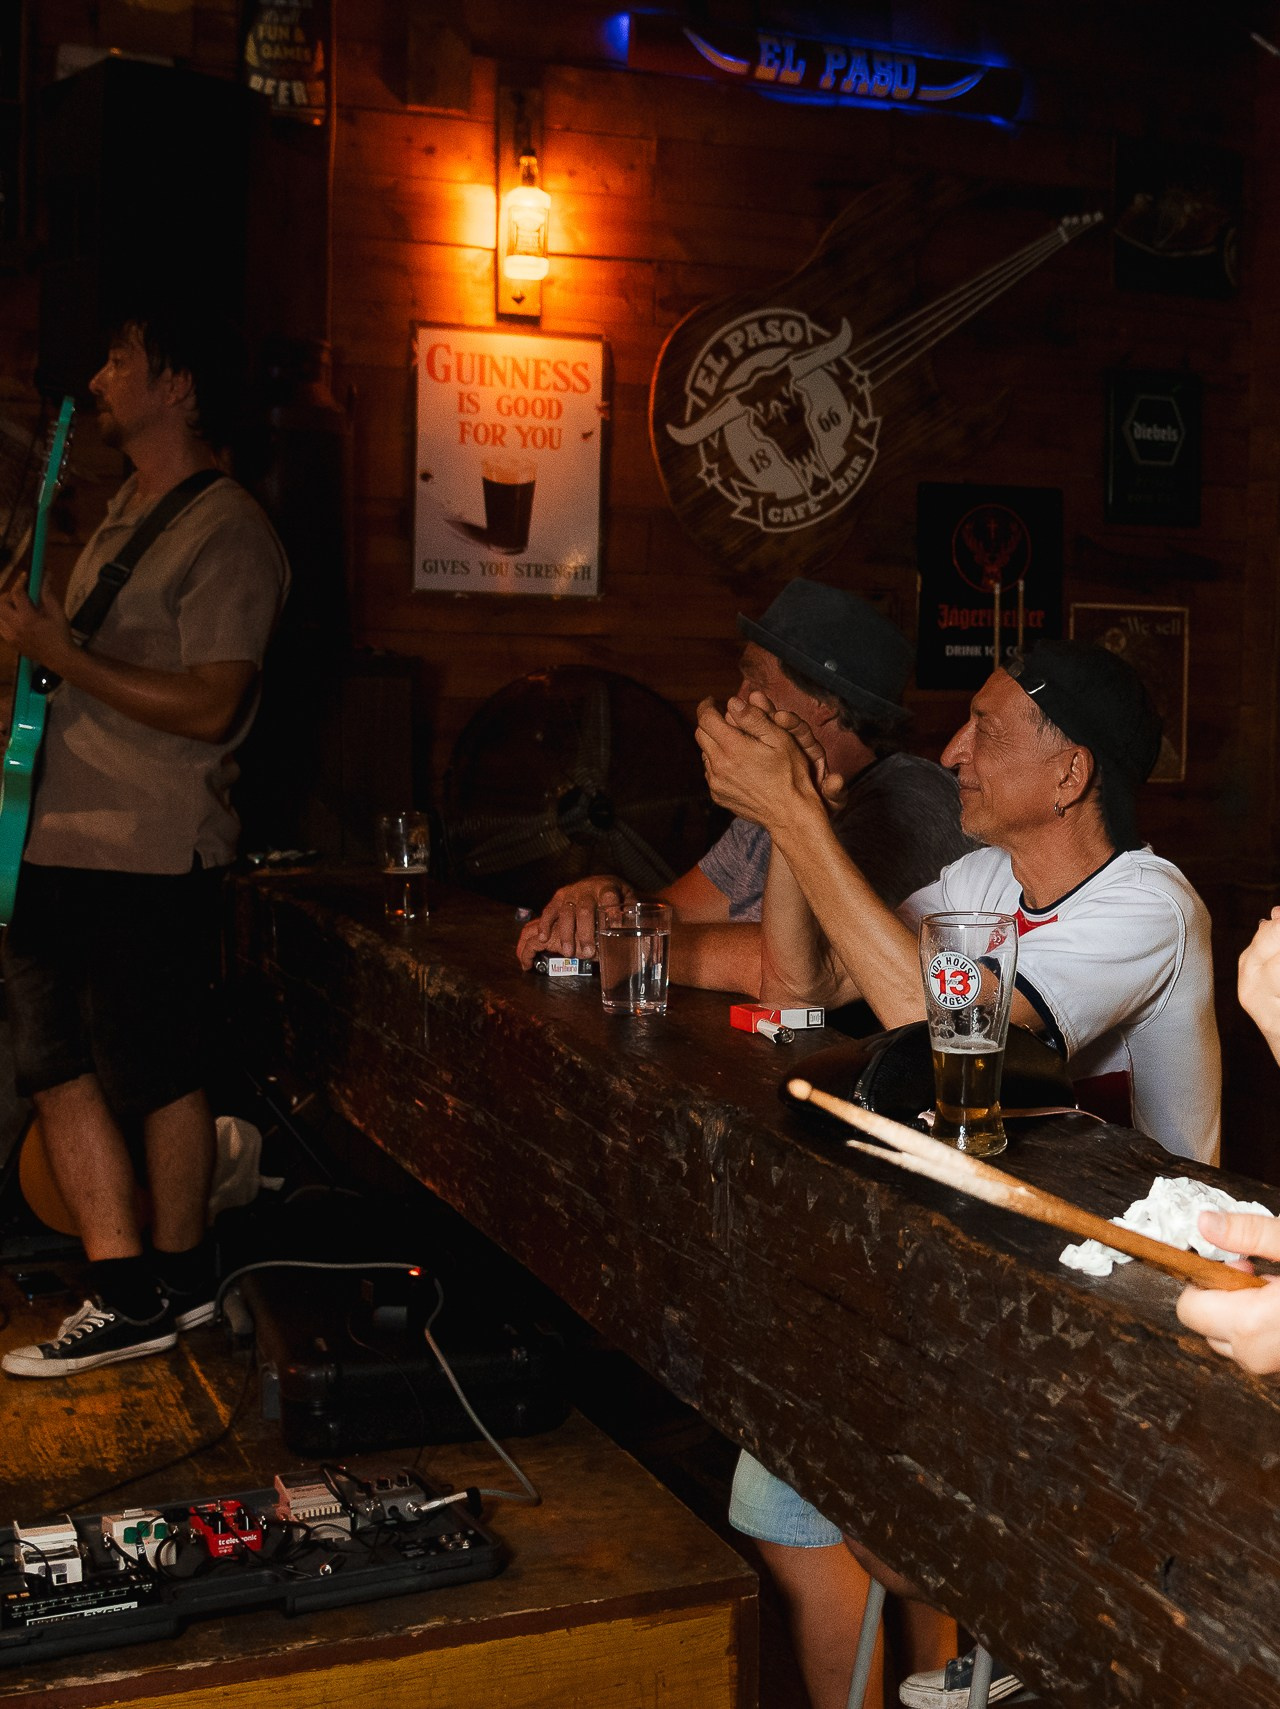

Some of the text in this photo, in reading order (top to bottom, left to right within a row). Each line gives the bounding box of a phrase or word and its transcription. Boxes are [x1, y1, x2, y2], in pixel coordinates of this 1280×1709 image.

[754, 34, 917, 99] EL PASO
[426, 343, 592, 395] GUINNESS
[694, 319, 804, 397] EL PASO
[458, 392, 563, 420] IS GOOD
[458, 421, 563, 450] FOR YOU
[748, 450, 772, 474] 18
[833, 455, 867, 497] BAR
[422, 559, 592, 581] GIVES YOU STRENGTH
[1155, 618, 1181, 636] sell
[944, 644, 982, 657] DRINK
[930, 956, 977, 981] HOP HOUSE
[935, 969, 971, 996] 13
[937, 992, 970, 1006] LAGER
